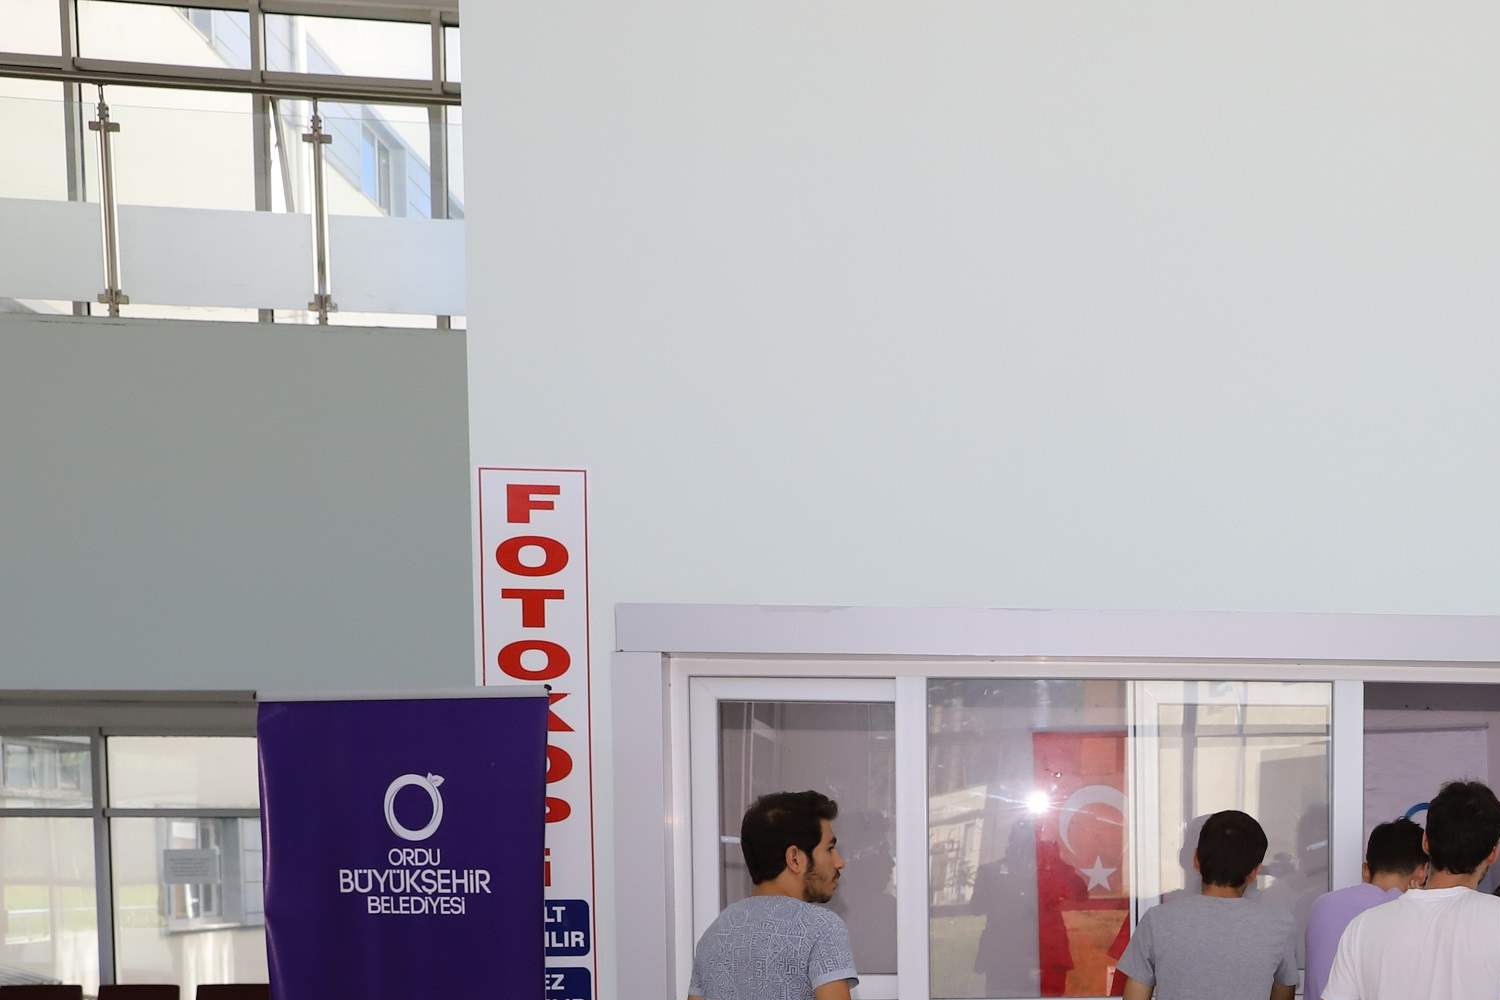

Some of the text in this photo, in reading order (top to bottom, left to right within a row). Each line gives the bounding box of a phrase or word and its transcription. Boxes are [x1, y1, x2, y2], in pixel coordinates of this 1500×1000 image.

[388, 848, 441, 866] ORDU
[339, 869, 492, 895] BÜYÜKŞEHİR
[367, 896, 466, 915] BELEDİYESİ
[544, 931, 585, 948] ILIR
